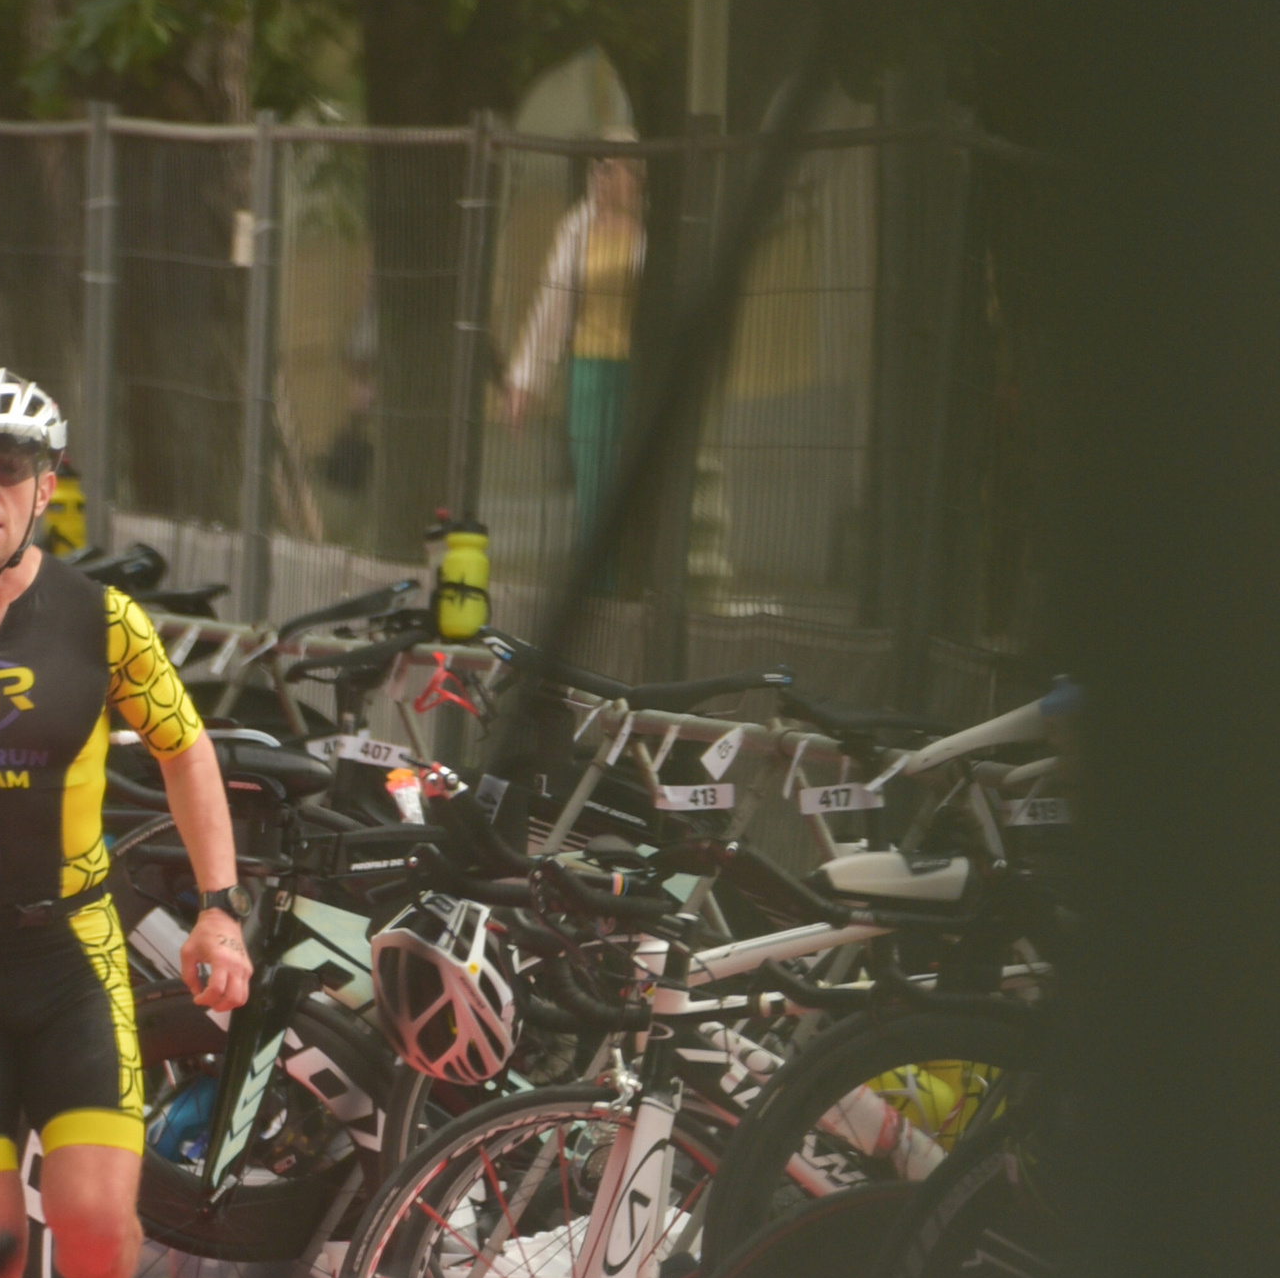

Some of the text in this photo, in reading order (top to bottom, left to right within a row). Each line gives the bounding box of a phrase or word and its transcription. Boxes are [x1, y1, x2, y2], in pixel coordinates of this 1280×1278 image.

[360, 742, 393, 762] 407
[687, 787, 718, 807] 413
[819, 787, 852, 808] 417
